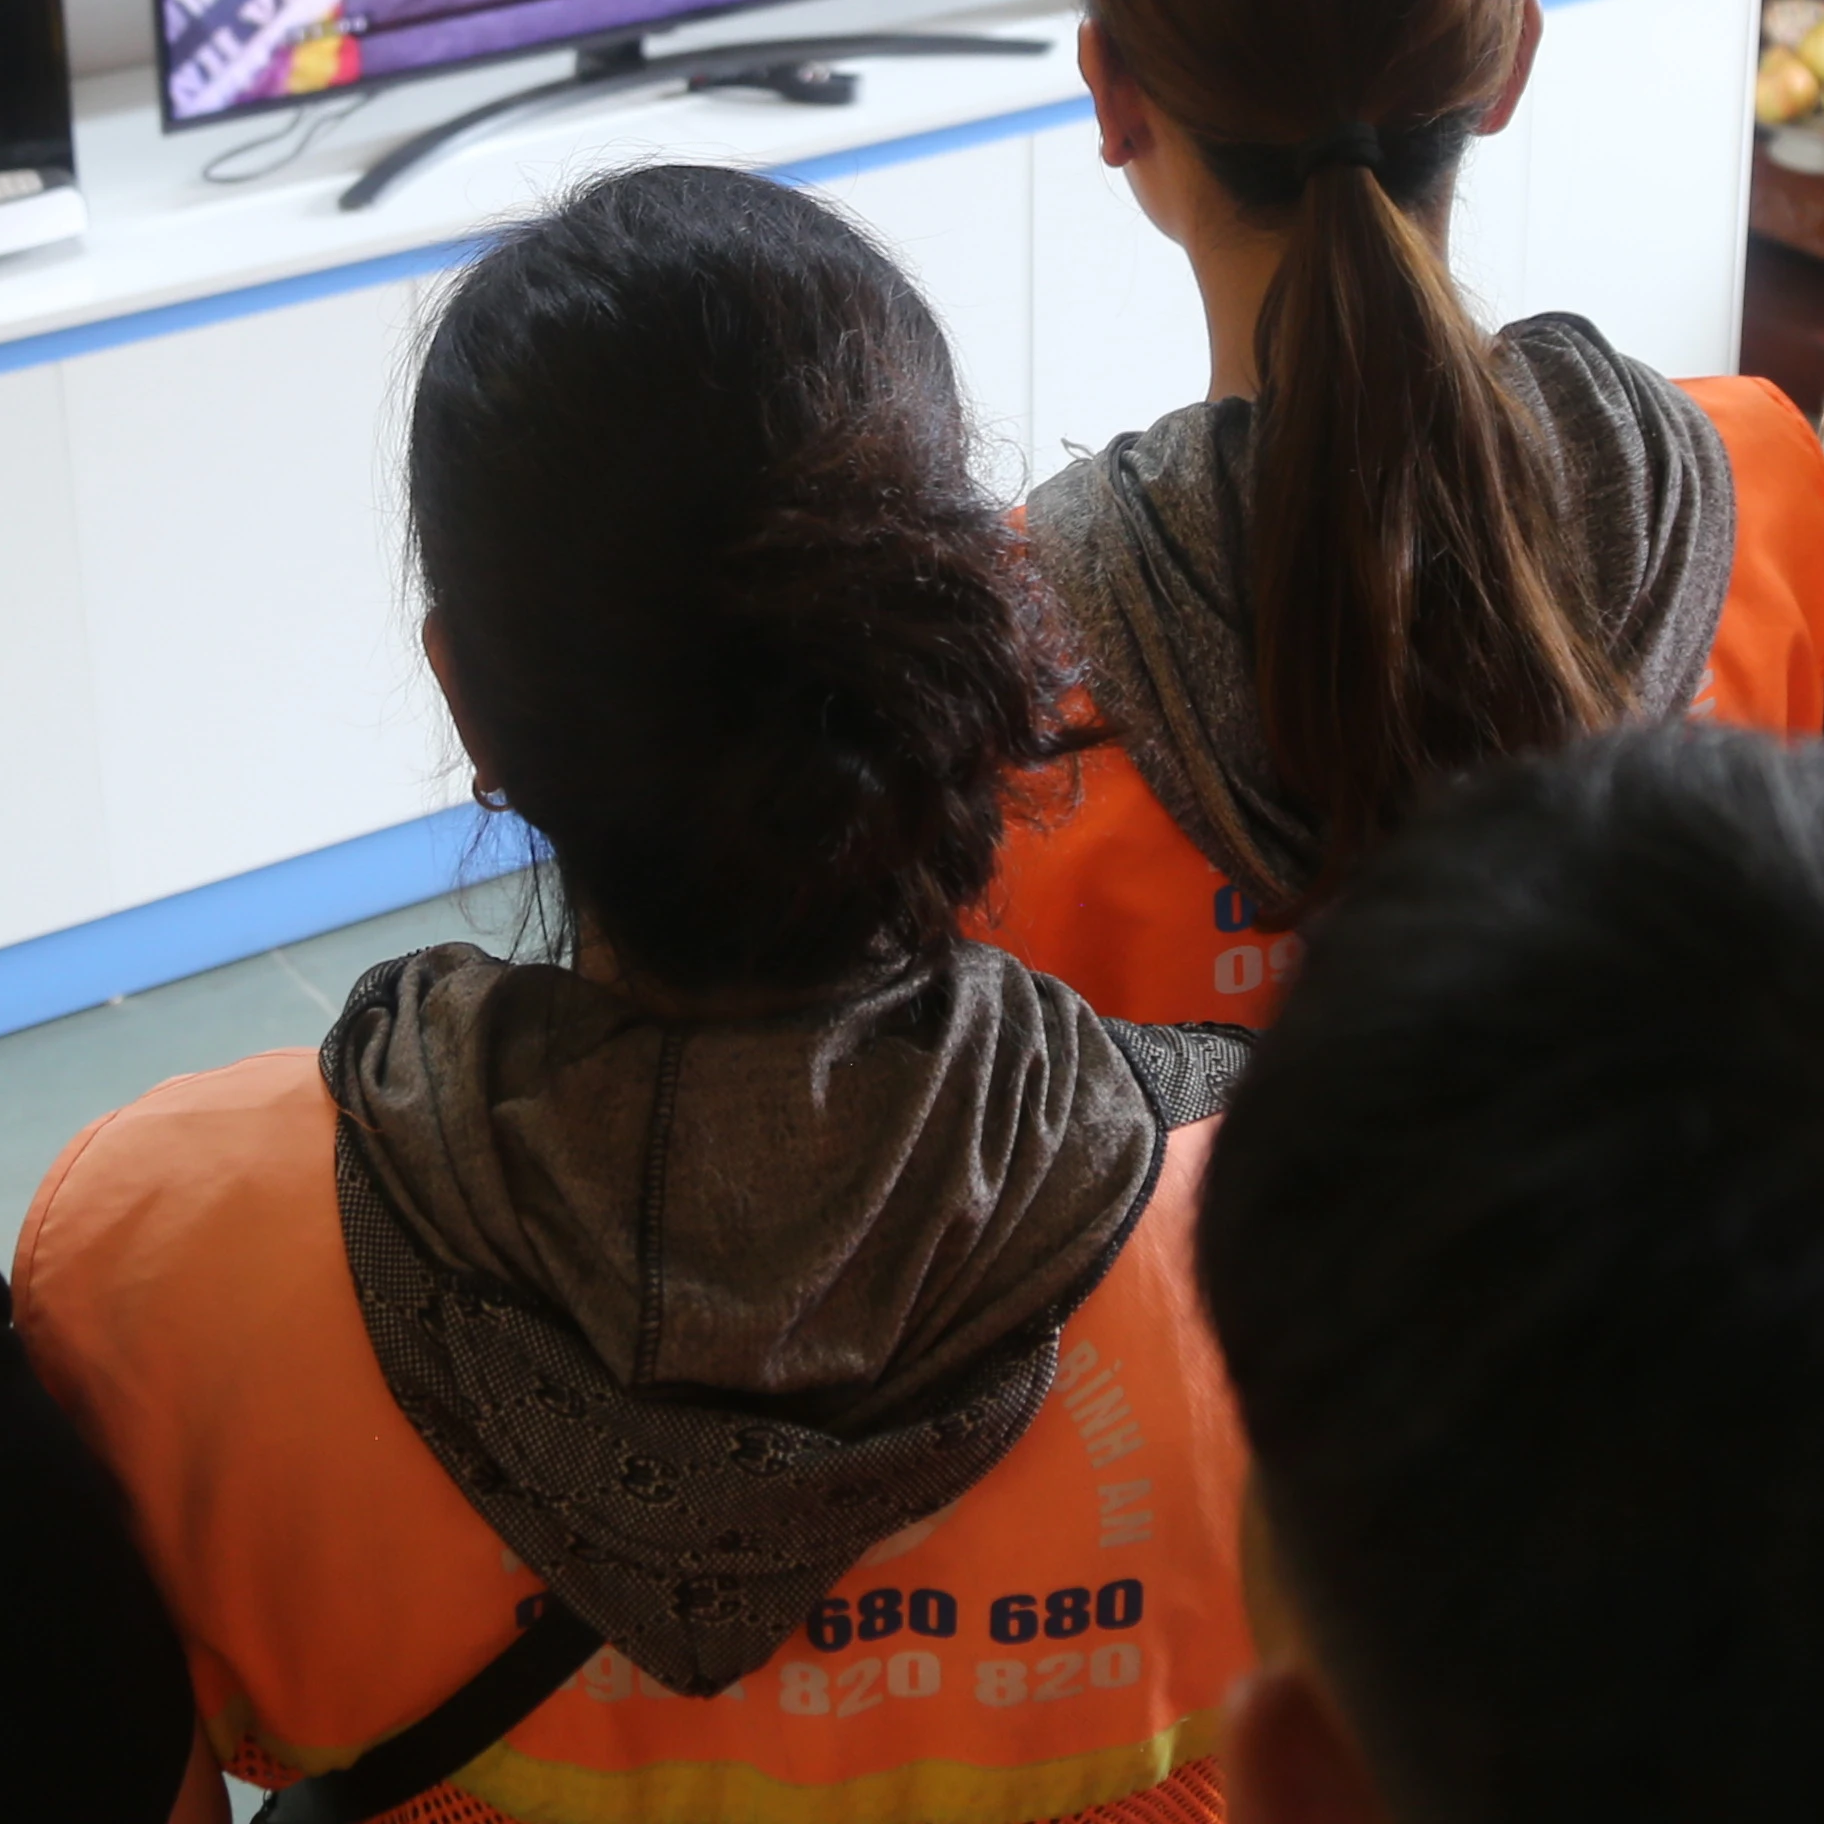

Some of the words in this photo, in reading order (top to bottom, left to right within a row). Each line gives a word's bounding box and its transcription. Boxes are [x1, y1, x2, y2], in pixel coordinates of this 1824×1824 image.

[1096, 1477, 1154, 1549] AN
[806, 1587, 958, 1653] 680
[989, 1578, 1144, 1646] 680
[779, 1649, 942, 1719] 820
[974, 1642, 1143, 1708] 820
